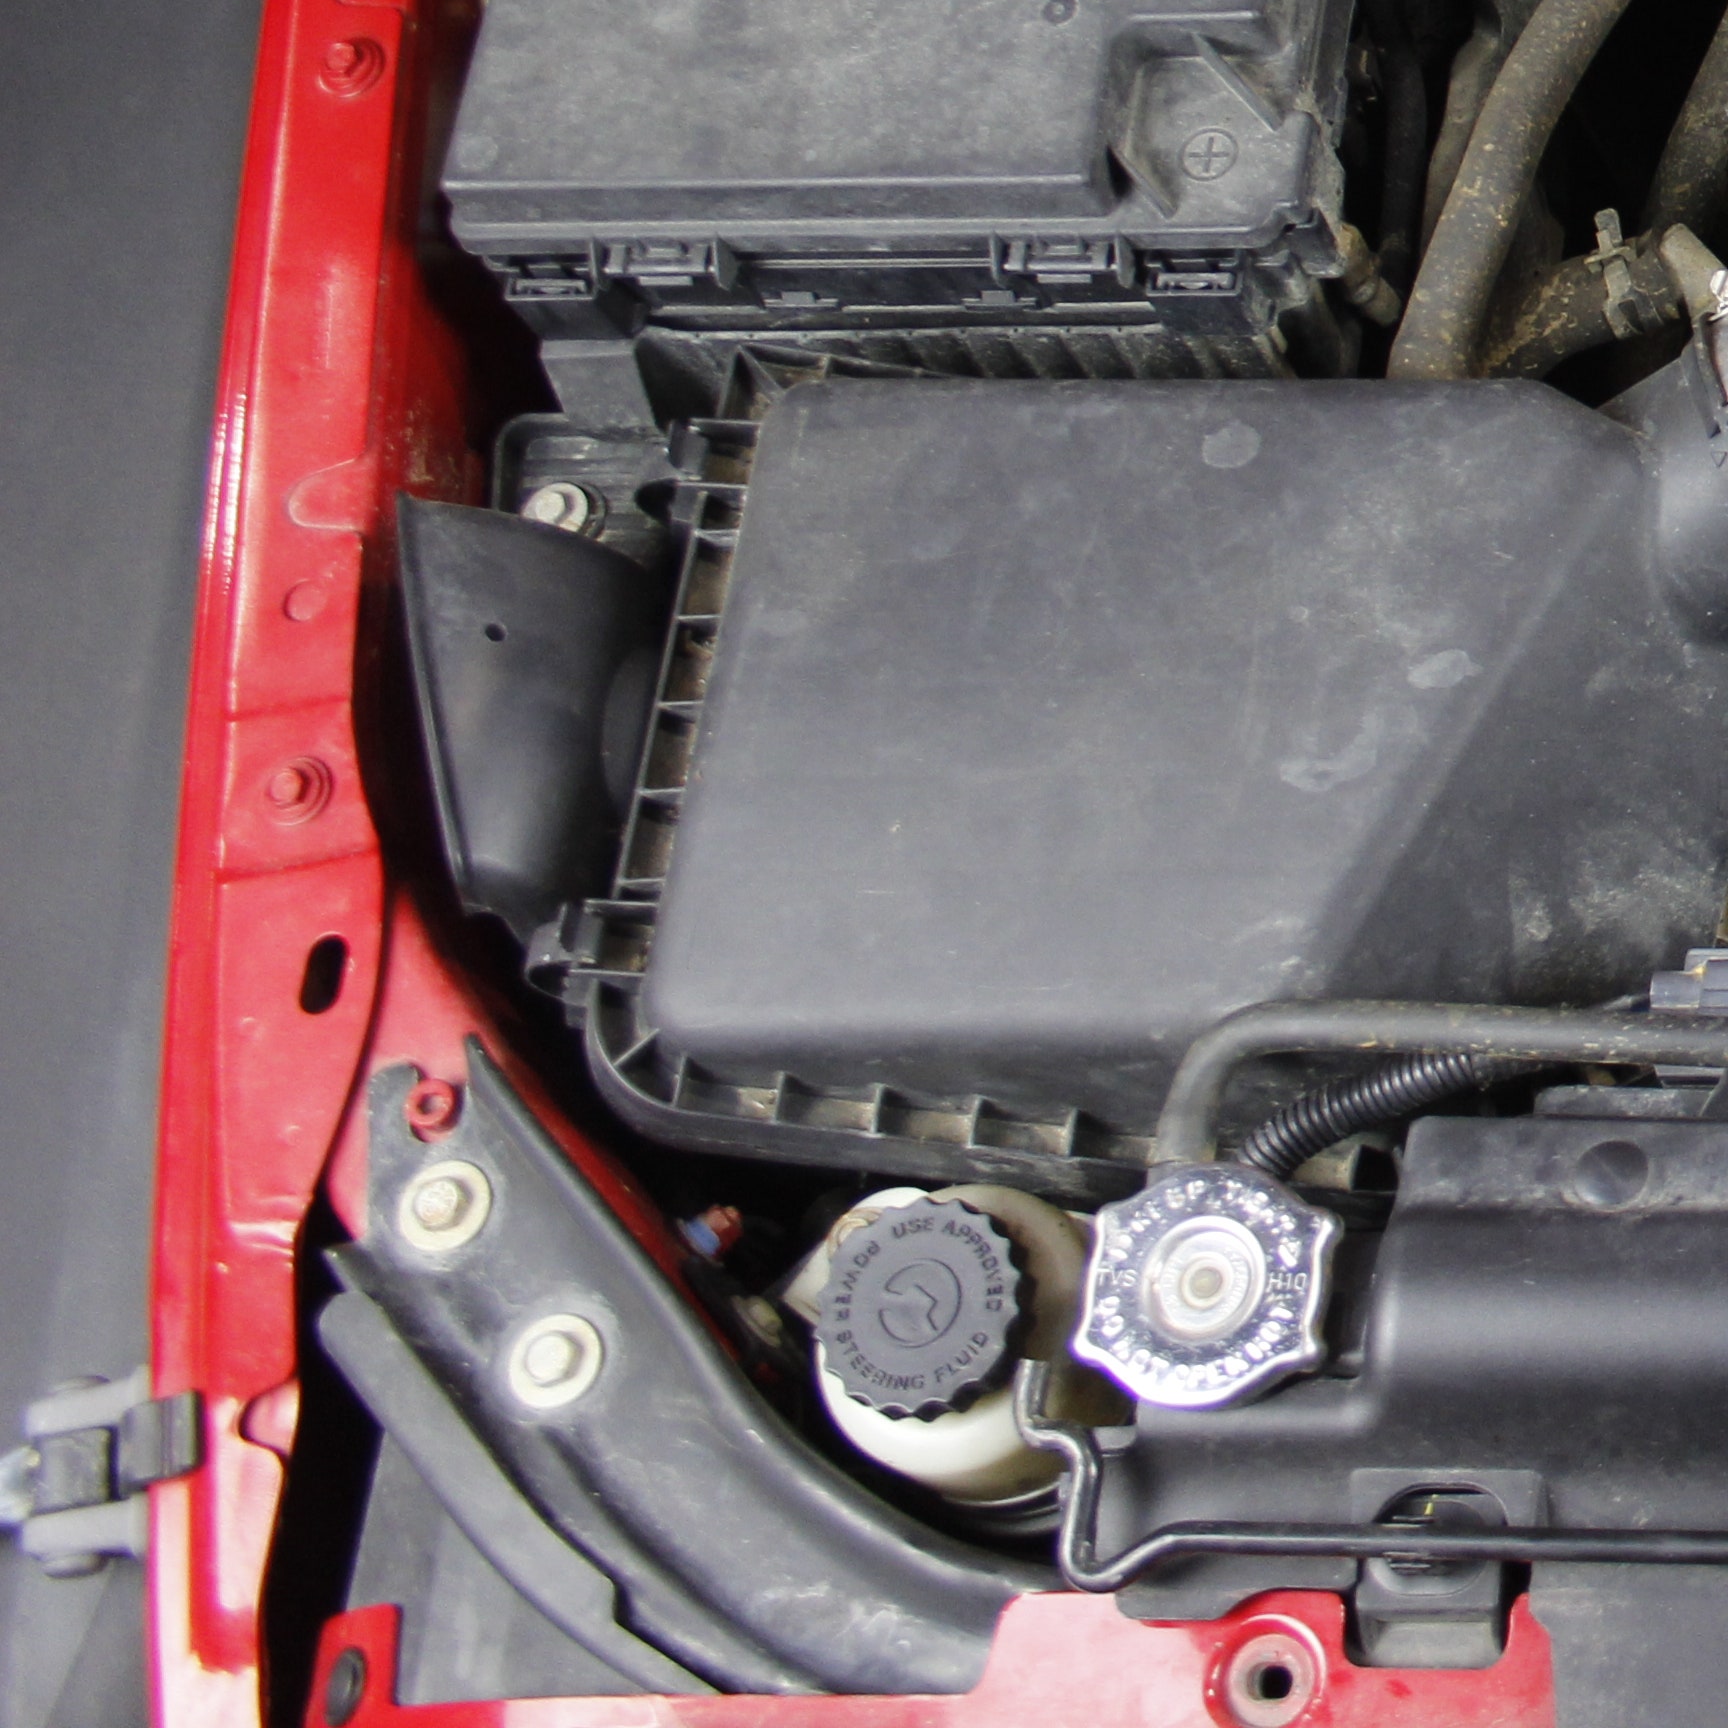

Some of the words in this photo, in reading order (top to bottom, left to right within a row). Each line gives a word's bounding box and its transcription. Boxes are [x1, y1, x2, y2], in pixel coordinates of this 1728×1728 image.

[834, 1240, 881, 1322] POWER
[891, 1218, 934, 1239] USE
[942, 1220, 1004, 1313] APPROVED
[1096, 1268, 1138, 1287] TVS
[836, 1330, 925, 1390] STEERING
[934, 1332, 989, 1383] FLUID
[1169, 1355, 1249, 1391] OPEN
